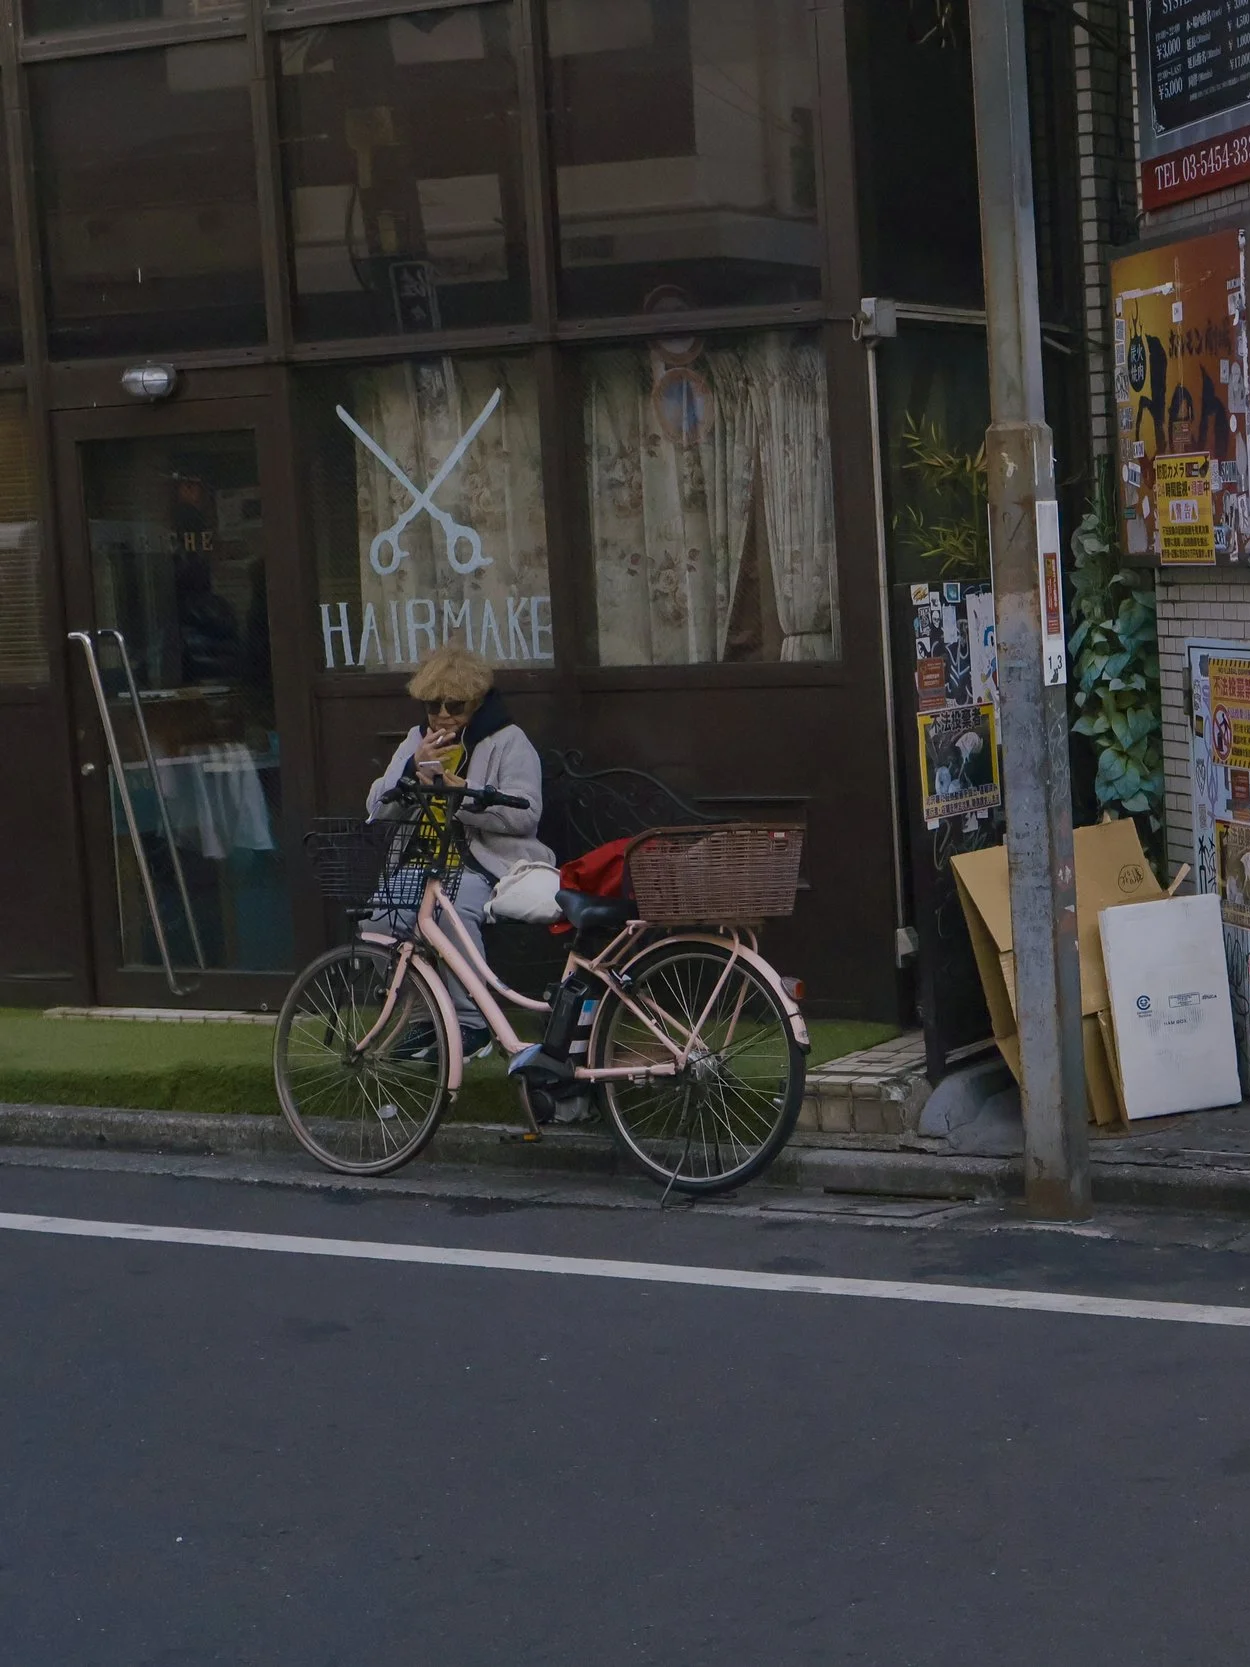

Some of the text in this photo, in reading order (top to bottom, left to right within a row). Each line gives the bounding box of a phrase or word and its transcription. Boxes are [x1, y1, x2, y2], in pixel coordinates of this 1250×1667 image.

[1156, 36, 1181, 60] ¥3,000
[1158, 77, 1183, 100] ¥5,000
[1155, 161, 1179, 190] TEL
[319, 596, 555, 669] HAIRMAKE
